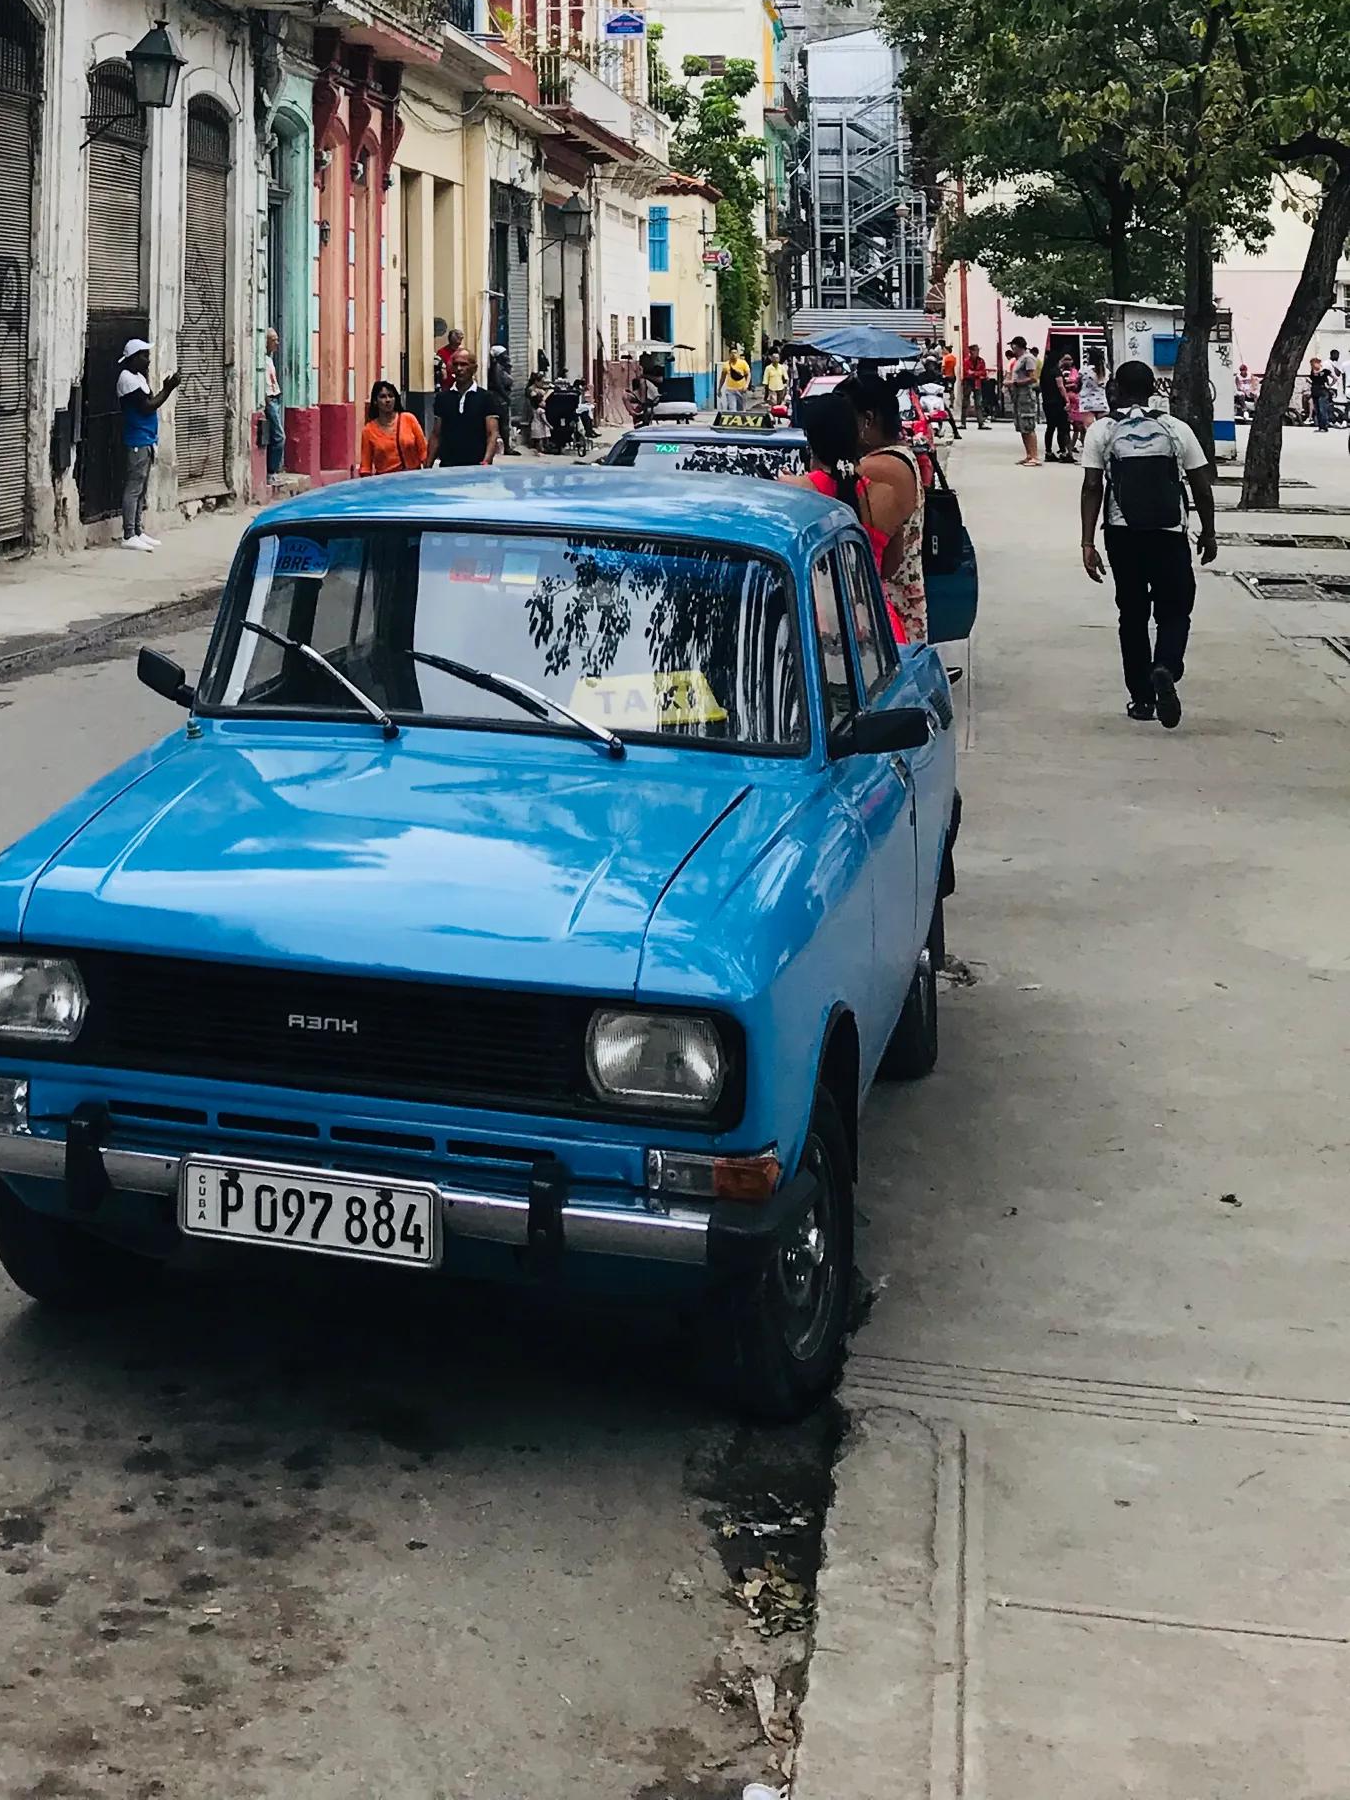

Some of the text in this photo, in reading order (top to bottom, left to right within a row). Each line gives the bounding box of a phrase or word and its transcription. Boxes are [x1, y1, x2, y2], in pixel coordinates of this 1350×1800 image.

[720, 414, 764, 427] TAXI
[655, 443, 681, 454] TAXI
[198, 1174, 207, 1221] CUBA
[220, 1176, 425, 1254] P 097 884
